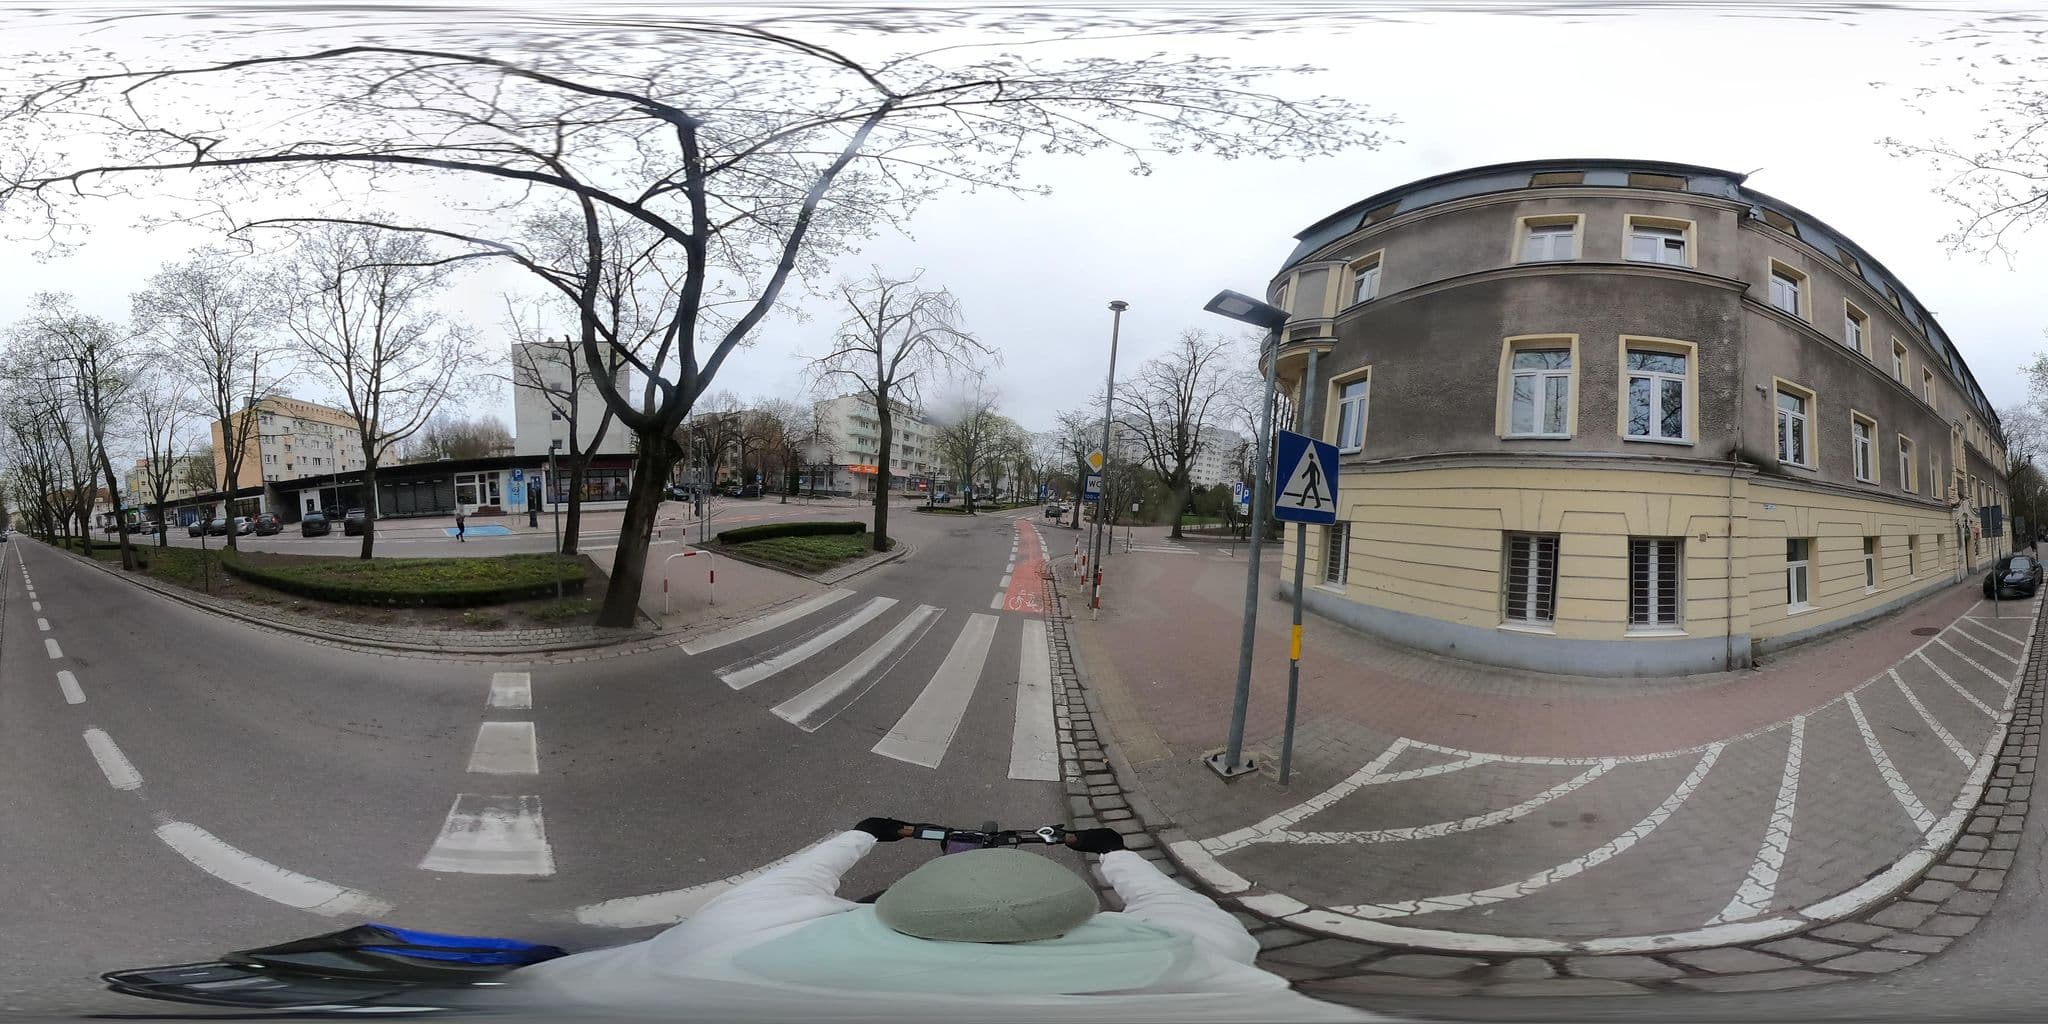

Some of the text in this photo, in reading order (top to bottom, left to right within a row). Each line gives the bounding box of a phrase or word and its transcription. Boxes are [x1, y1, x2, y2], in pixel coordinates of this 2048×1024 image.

[515, 469, 522, 478] P
[1089, 480, 1101, 488] WC
[1243, 489, 1249, 499] P
